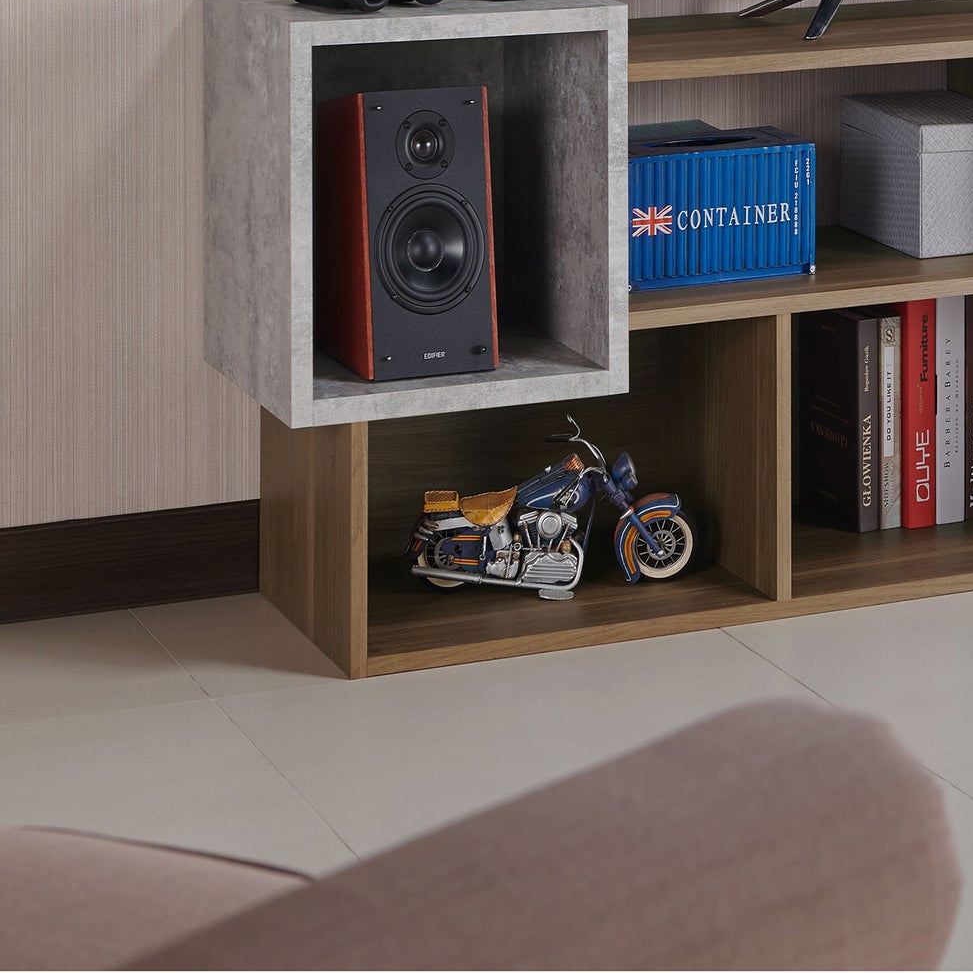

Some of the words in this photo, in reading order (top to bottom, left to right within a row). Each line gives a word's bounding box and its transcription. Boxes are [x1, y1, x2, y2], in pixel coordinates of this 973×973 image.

[677, 202, 791, 231] CONTAINER
[920, 314, 928, 382] Furniture
[886, 370, 892, 380] IT
[886, 427, 892, 441] DO
[916, 429, 930, 502] OUYE
